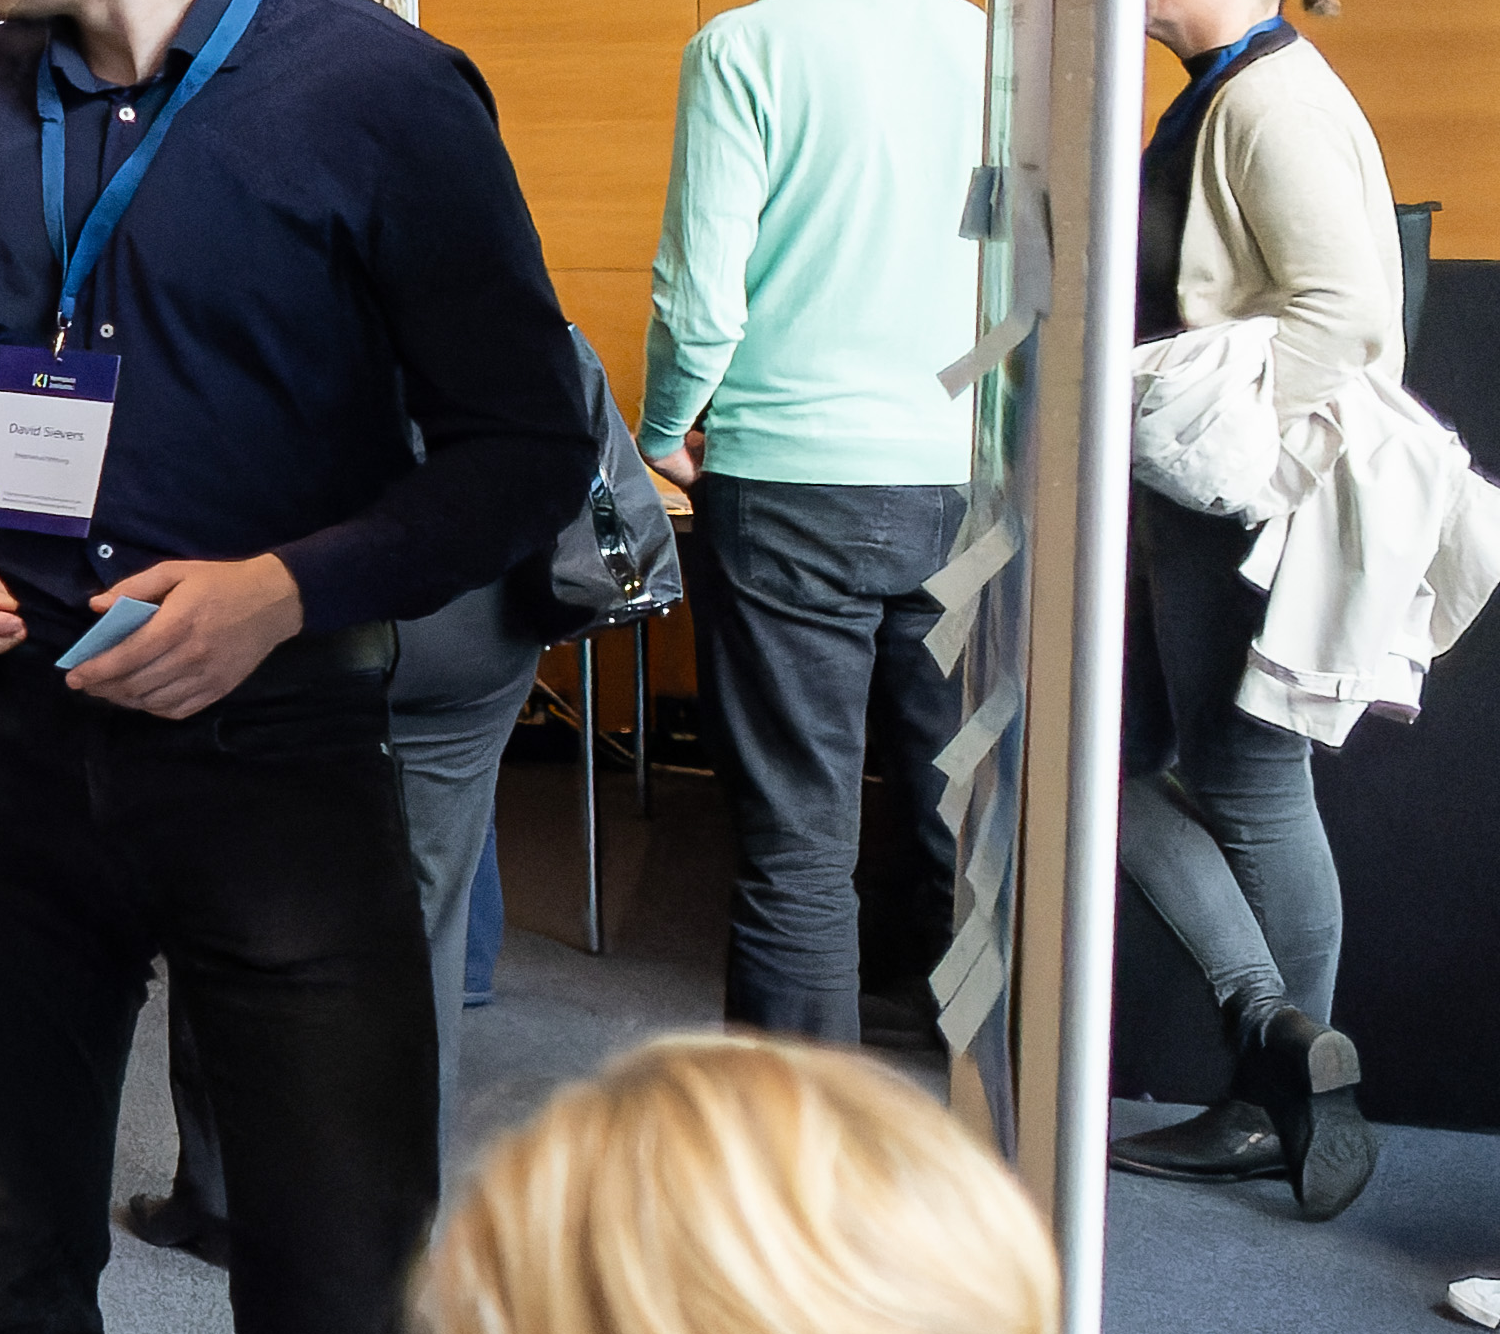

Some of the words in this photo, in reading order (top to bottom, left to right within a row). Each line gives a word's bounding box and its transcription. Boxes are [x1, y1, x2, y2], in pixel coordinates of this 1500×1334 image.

[32, 373, 48, 388] KI
[9, 423, 41, 436] David
[44, 427, 85, 441] Sievers
